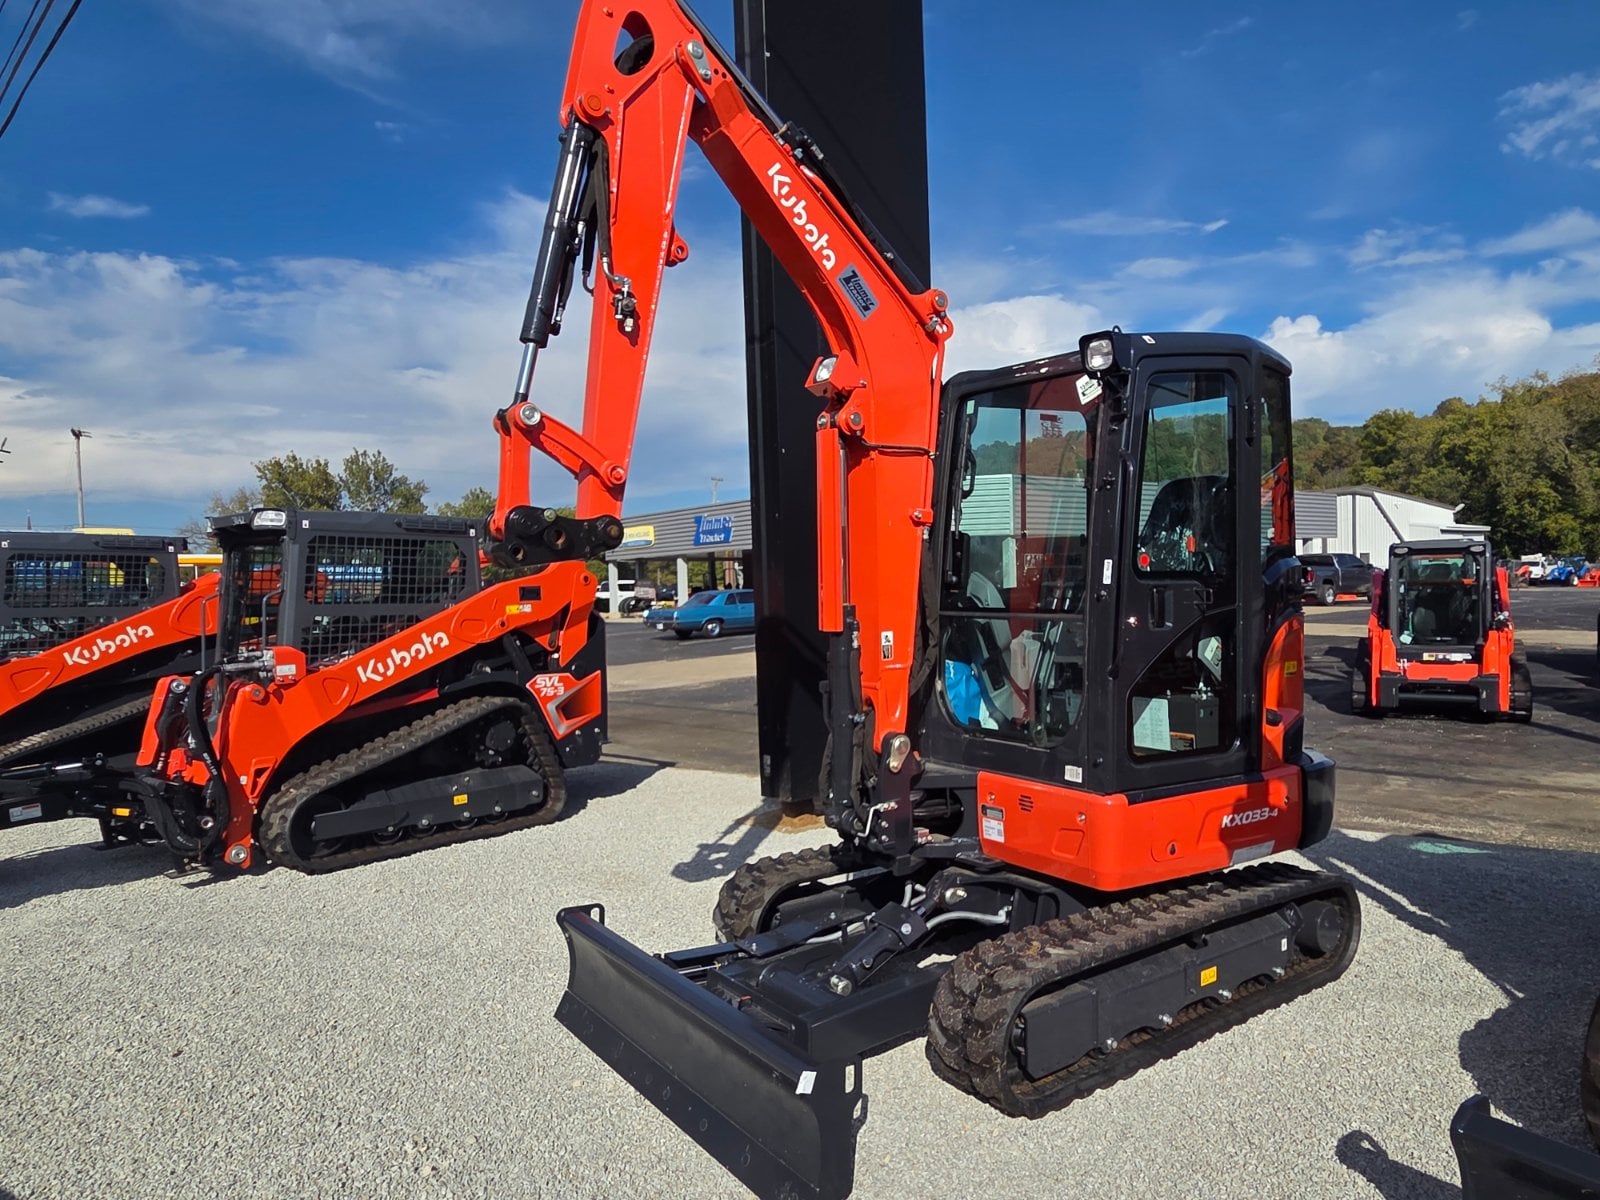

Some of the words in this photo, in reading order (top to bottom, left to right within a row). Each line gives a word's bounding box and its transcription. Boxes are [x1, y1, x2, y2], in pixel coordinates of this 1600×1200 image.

[767, 162, 836, 271] Kubota
[64, 625, 154, 666] Kubota
[356, 630, 450, 683] Kubota
[535, 676, 564, 688] SVL
[540, 687, 565, 697] 75-3
[1221, 808, 1278, 828] KX033-4
